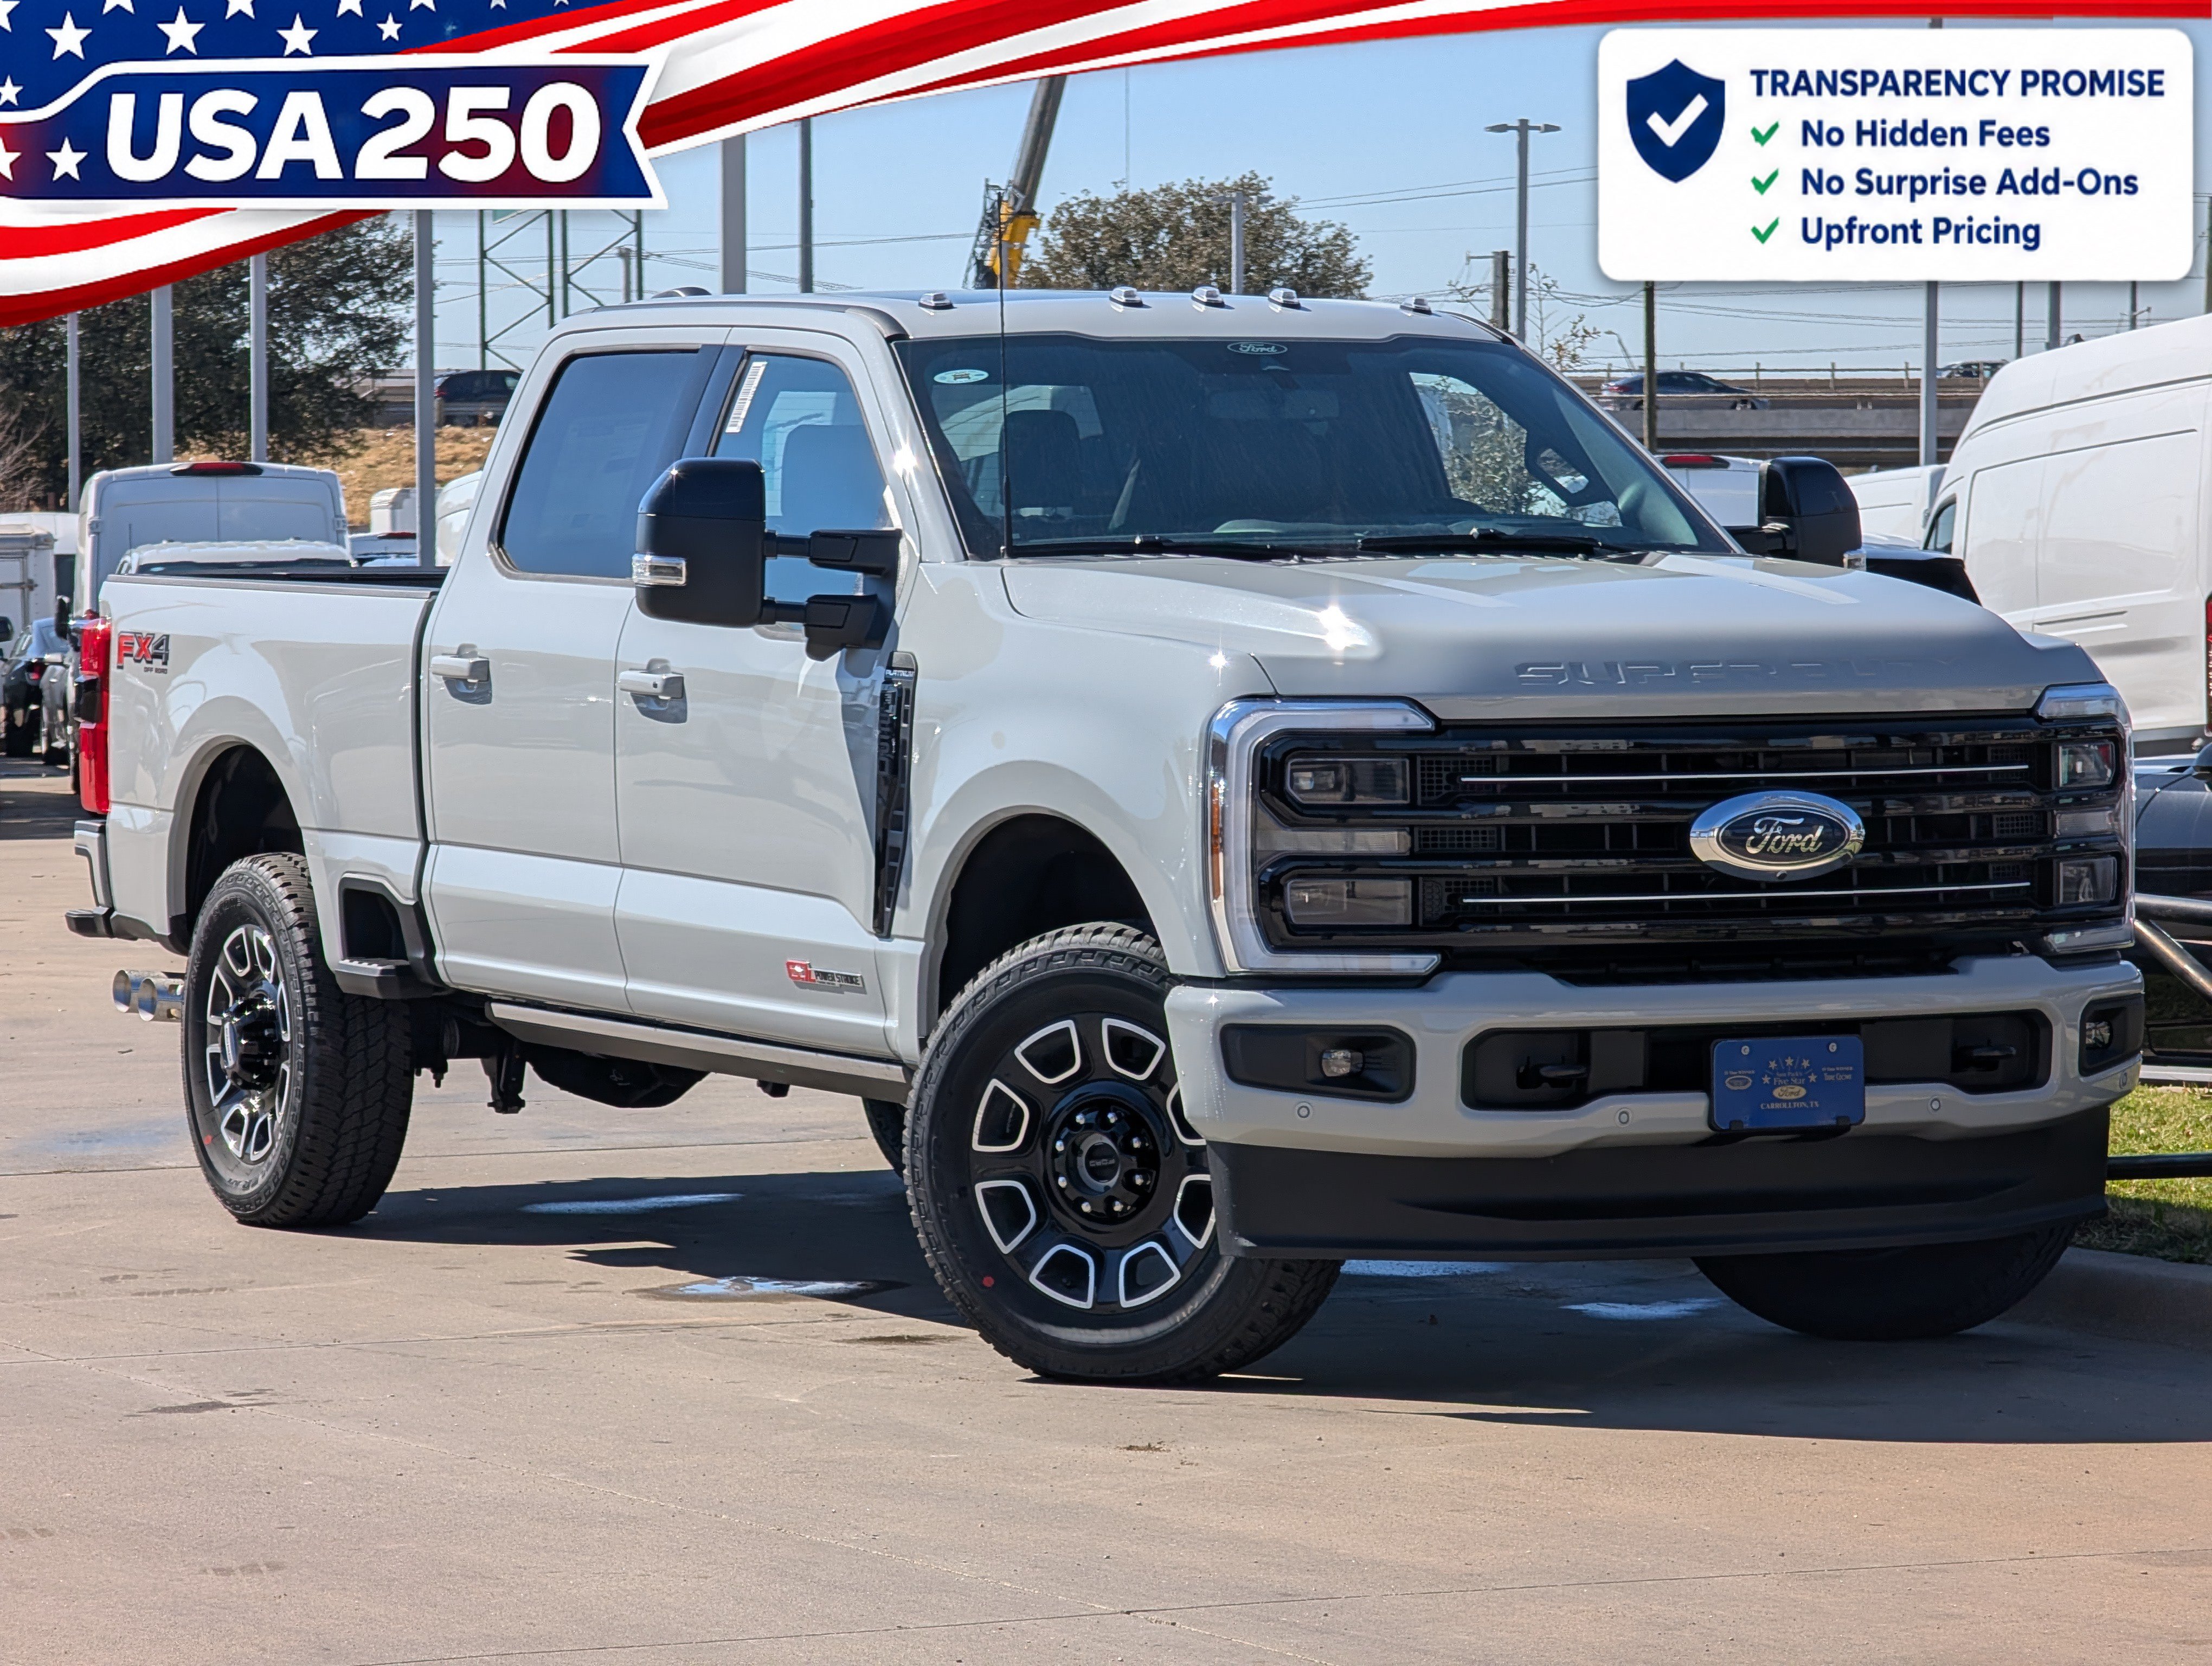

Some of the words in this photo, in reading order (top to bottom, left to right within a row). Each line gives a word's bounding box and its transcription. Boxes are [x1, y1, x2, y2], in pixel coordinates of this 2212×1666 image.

[1239, 343, 1277, 353] Ford
[117, 631, 170, 670] FX4
[1515, 660, 1778, 685] SUPER
[1746, 817, 1824, 854] Ford
[1778, 1086, 1801, 1097] Ford
